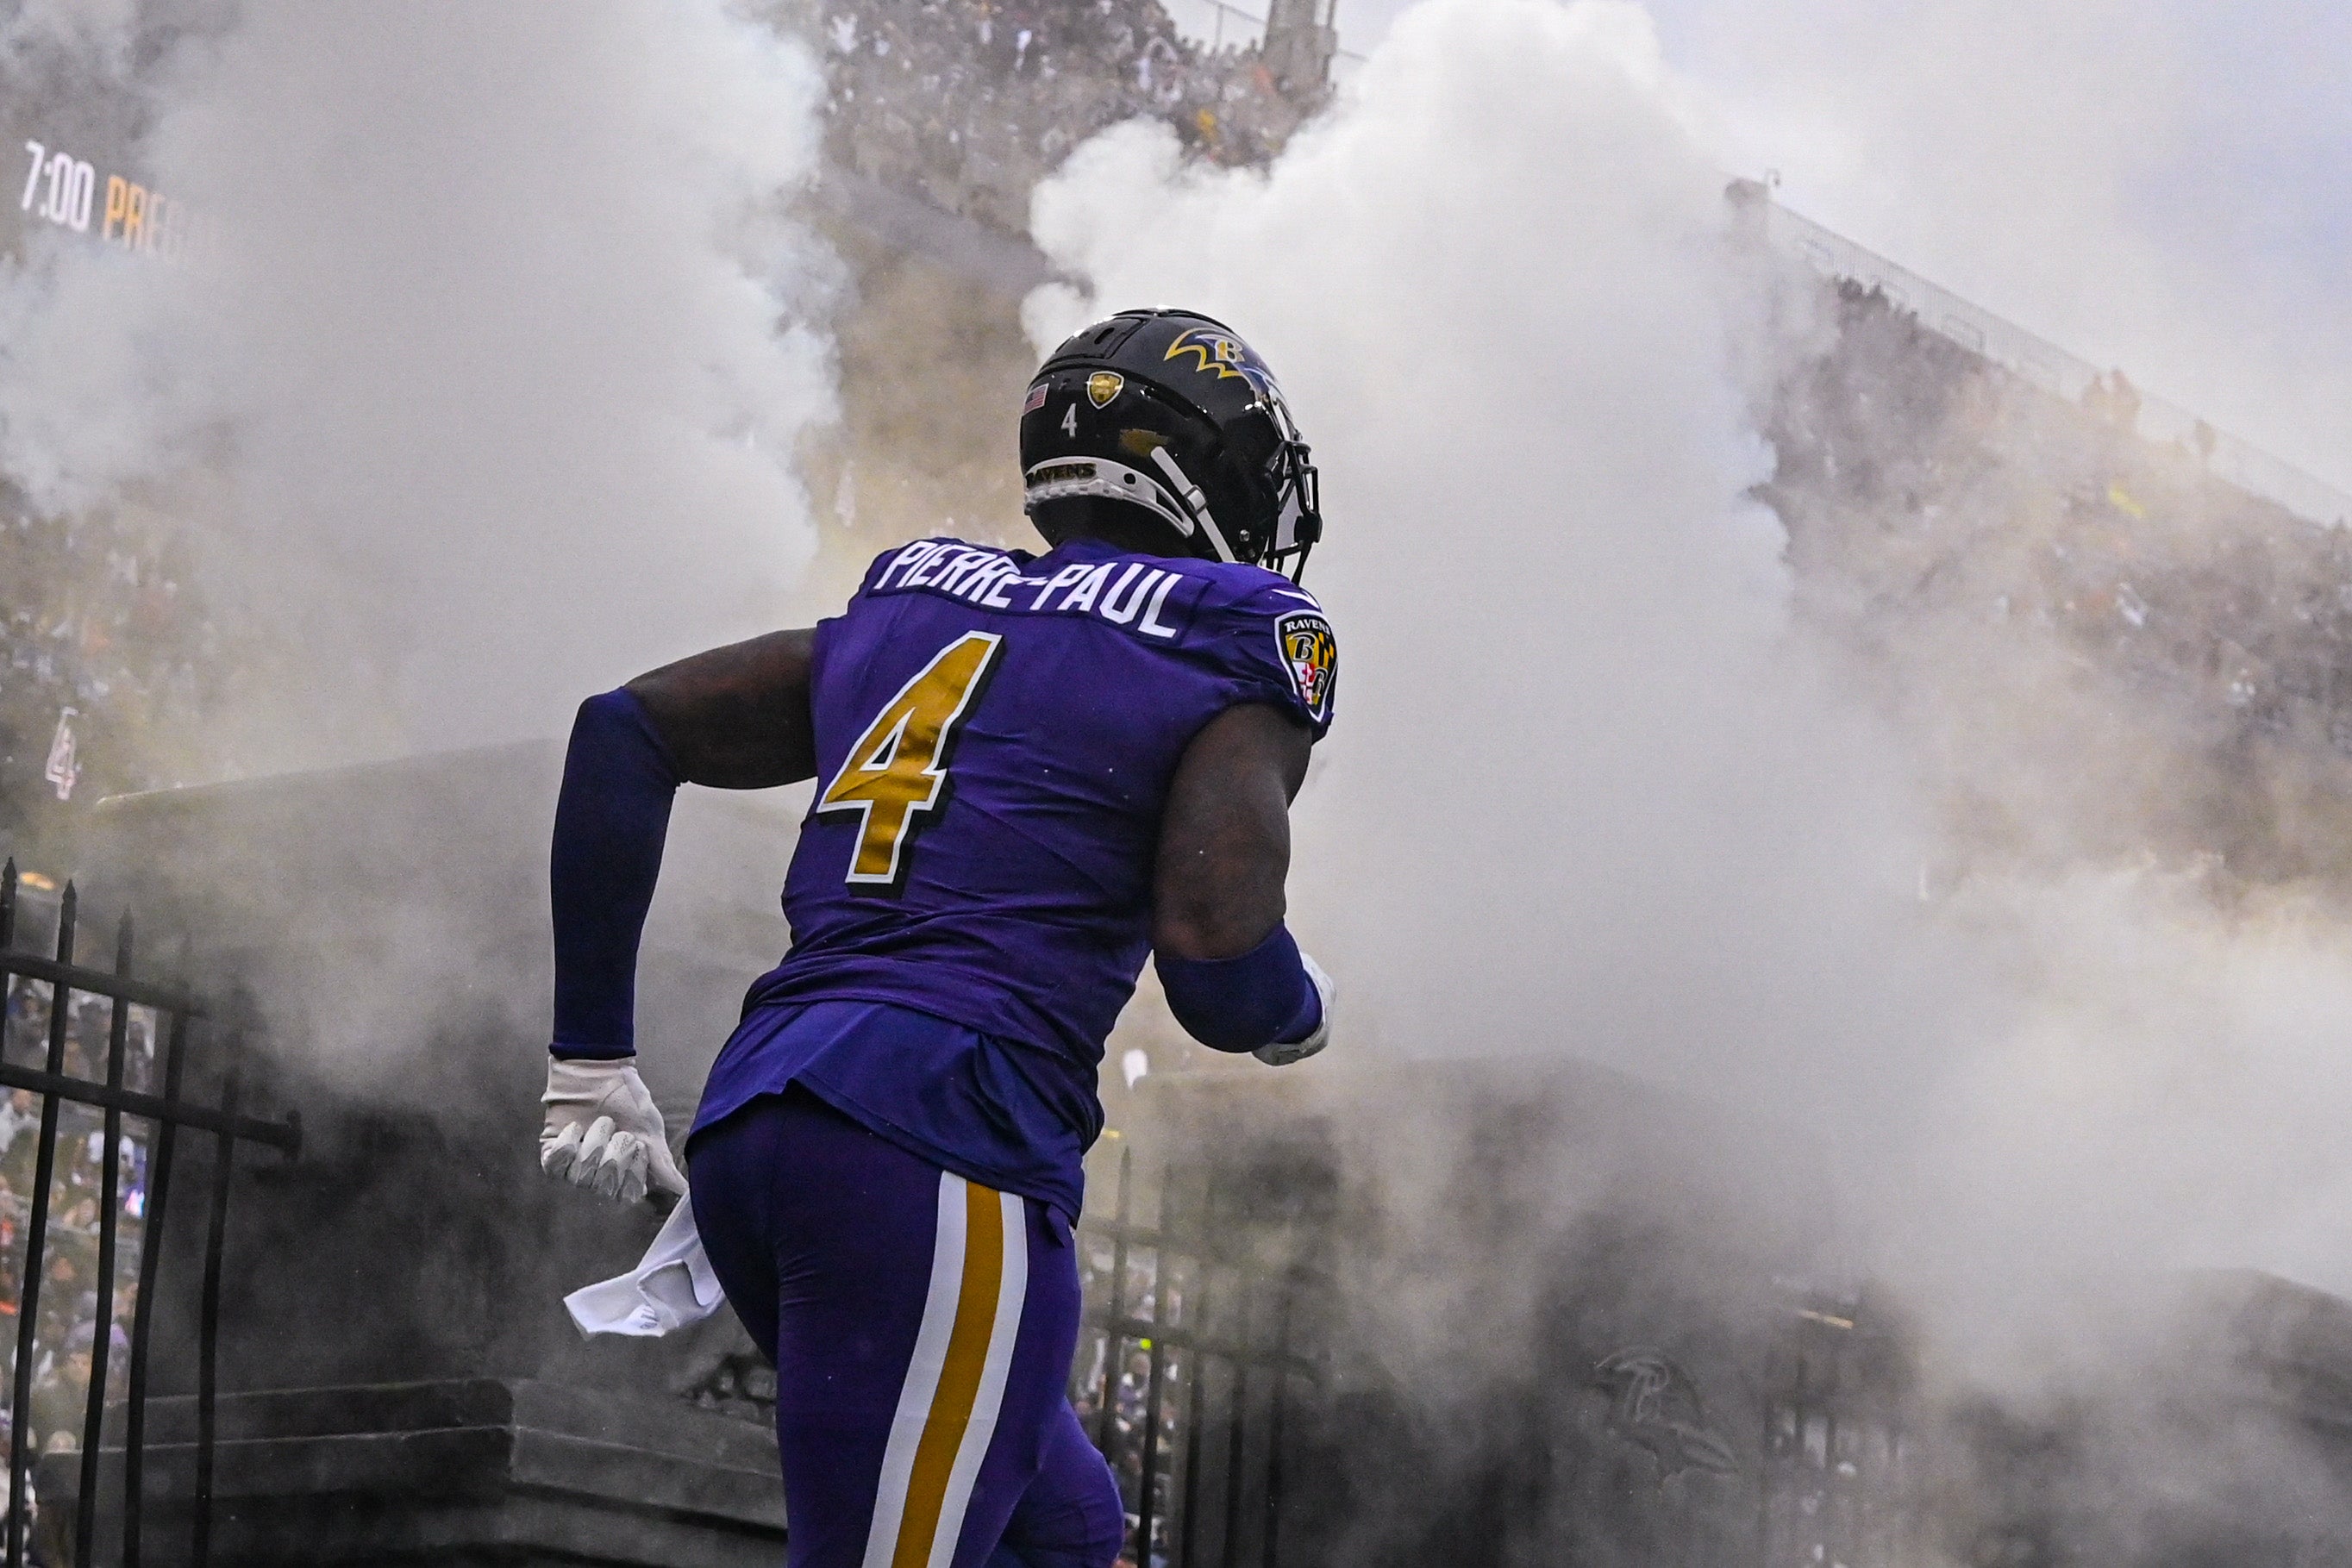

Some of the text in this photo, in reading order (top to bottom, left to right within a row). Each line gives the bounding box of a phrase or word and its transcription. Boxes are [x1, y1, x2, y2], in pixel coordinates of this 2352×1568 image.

[21, 140, 96, 232] 7:00
[1060, 402, 1079, 439] 4
[873, 540, 1184, 638] PIERRE-PAUL
[815, 629, 1004, 886] 4
